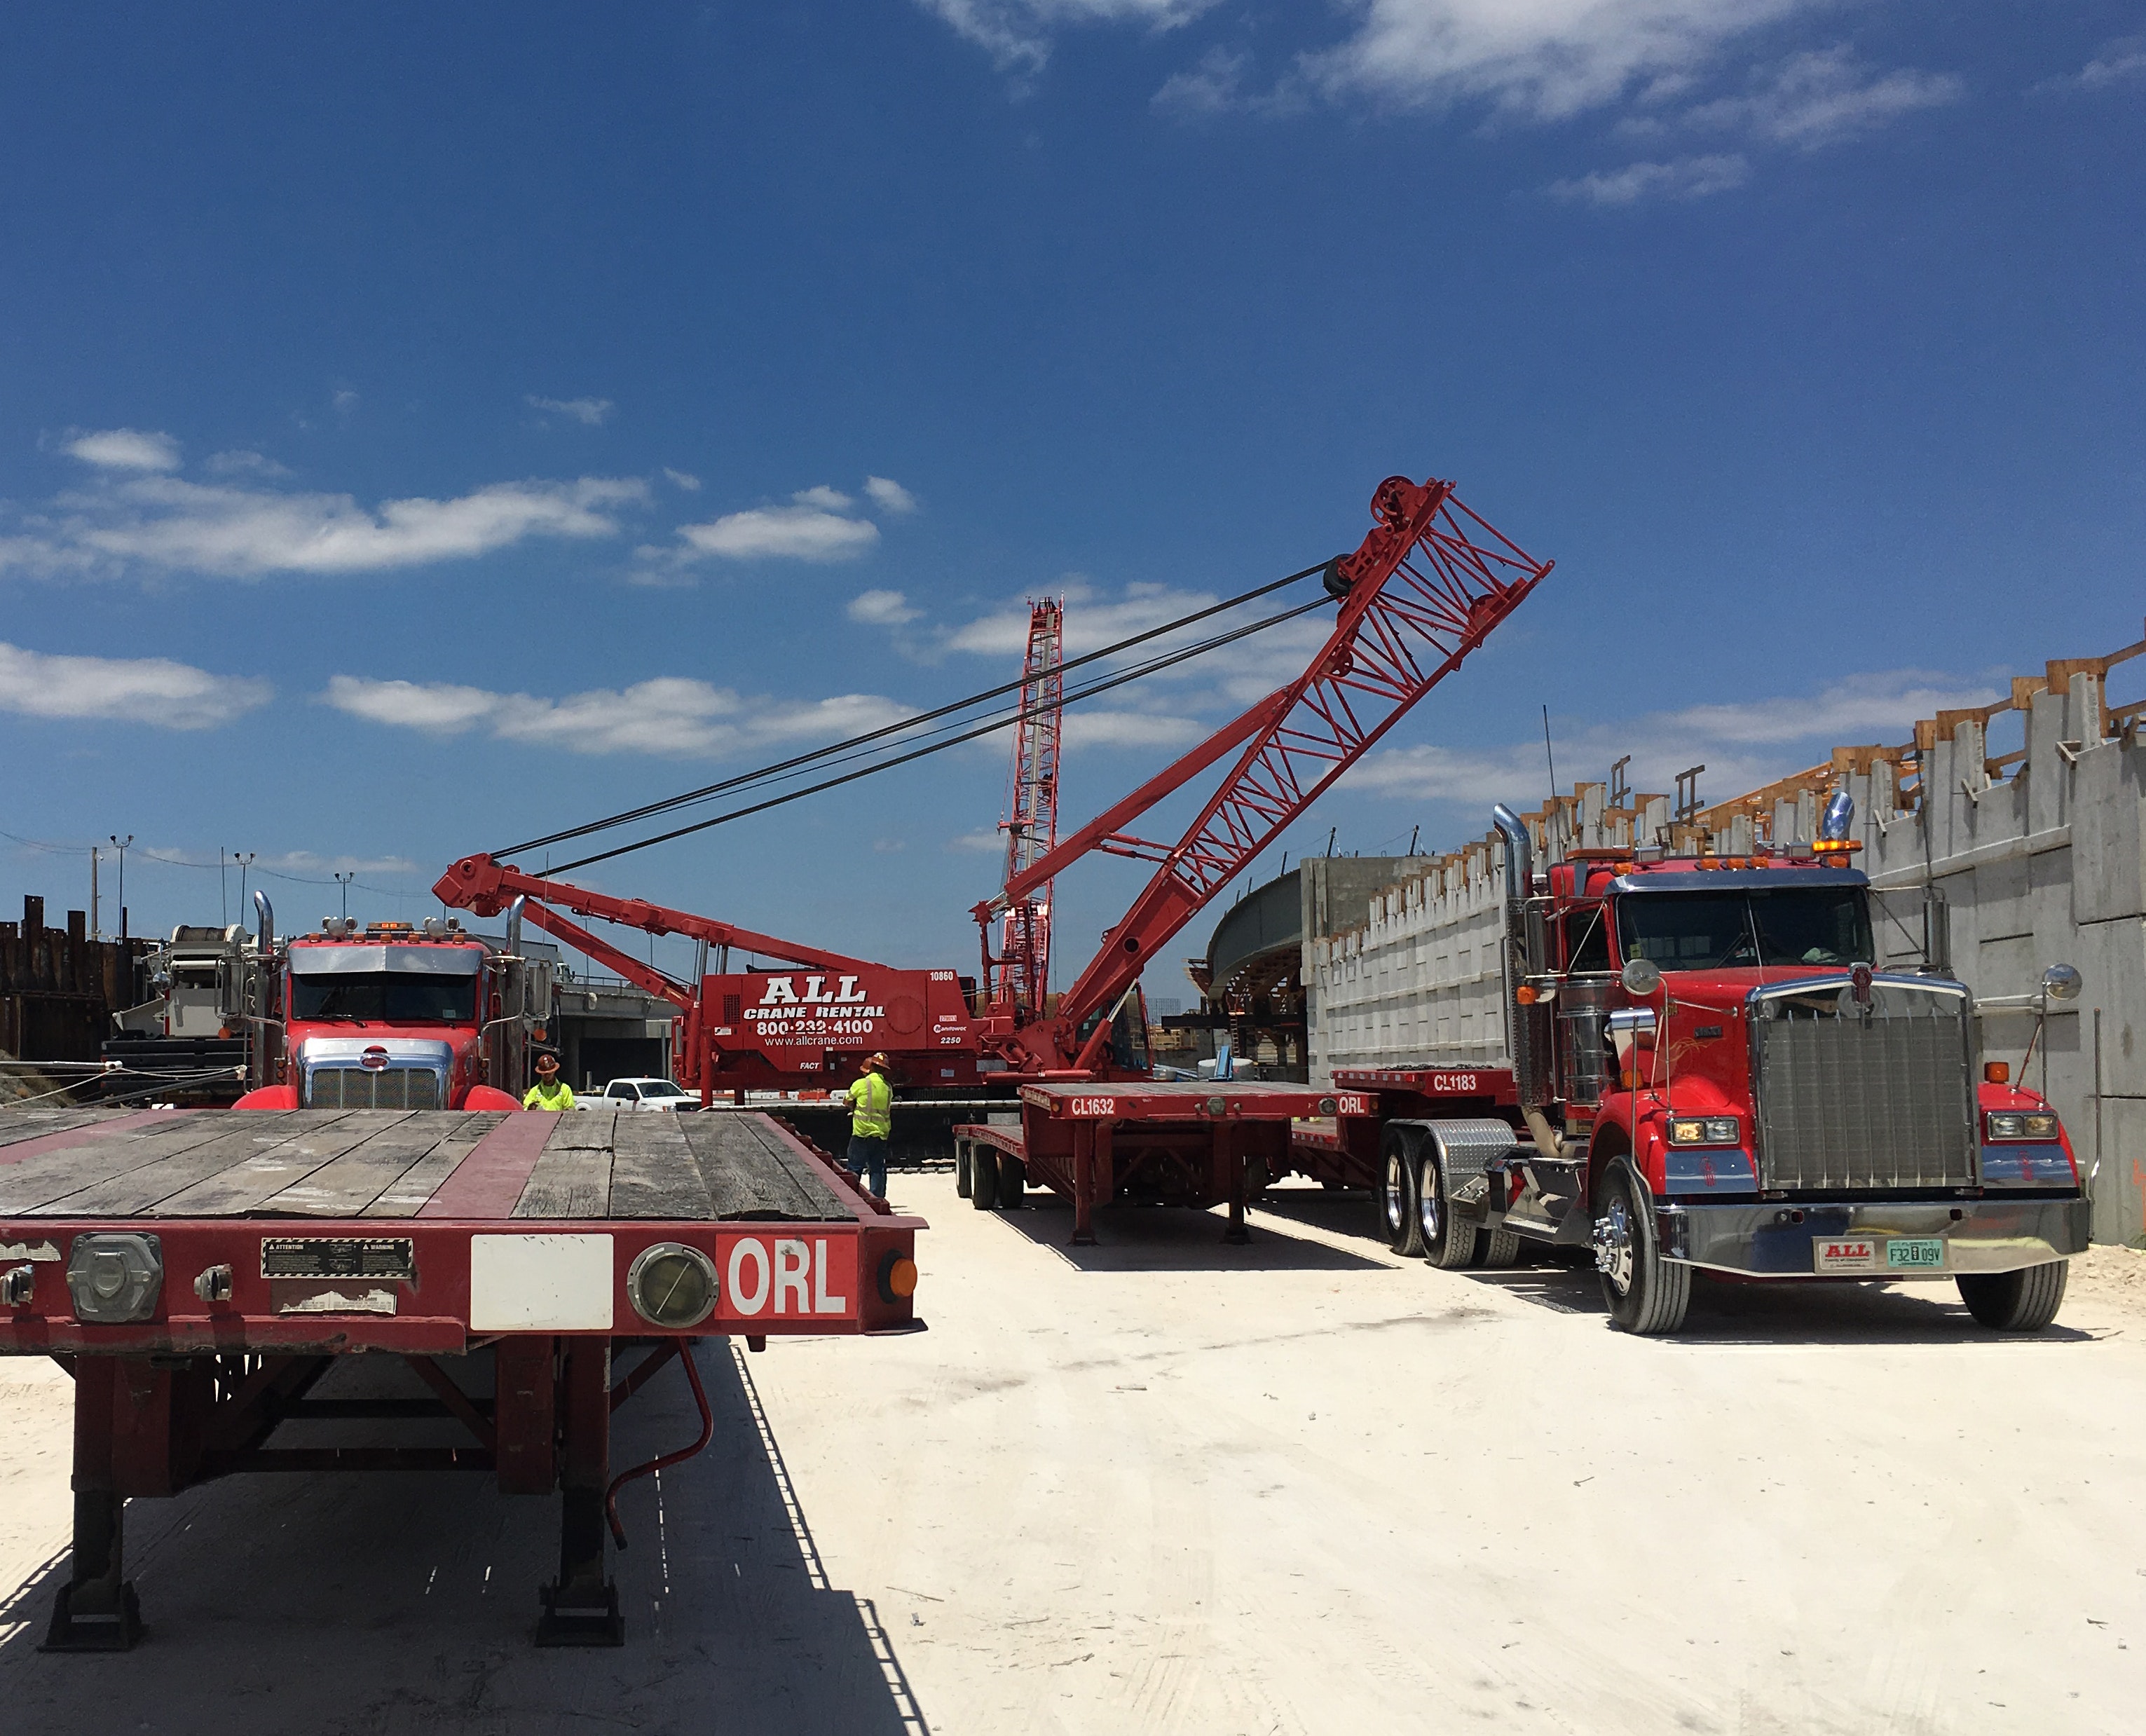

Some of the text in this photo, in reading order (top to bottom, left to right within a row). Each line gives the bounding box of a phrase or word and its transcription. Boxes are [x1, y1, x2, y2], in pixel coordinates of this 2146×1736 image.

[930, 971, 954, 981] 10860
[758, 975, 867, 1005] ALL
[743, 1006, 886, 1020] CRANE RENTAL
[764, 1035, 863, 1046] www.allcrane.com
[800, 1062, 820, 1070] FACT
[1434, 1074, 1477, 1091] CL1183
[1072, 1098, 1114, 1116] CL1632
[1339, 1096, 1365, 1114] ORL
[1824, 1244, 1871, 1257] ALL
[1890, 1248, 1941, 1262] F32 09V
[727, 1237, 846, 1315] ORL
